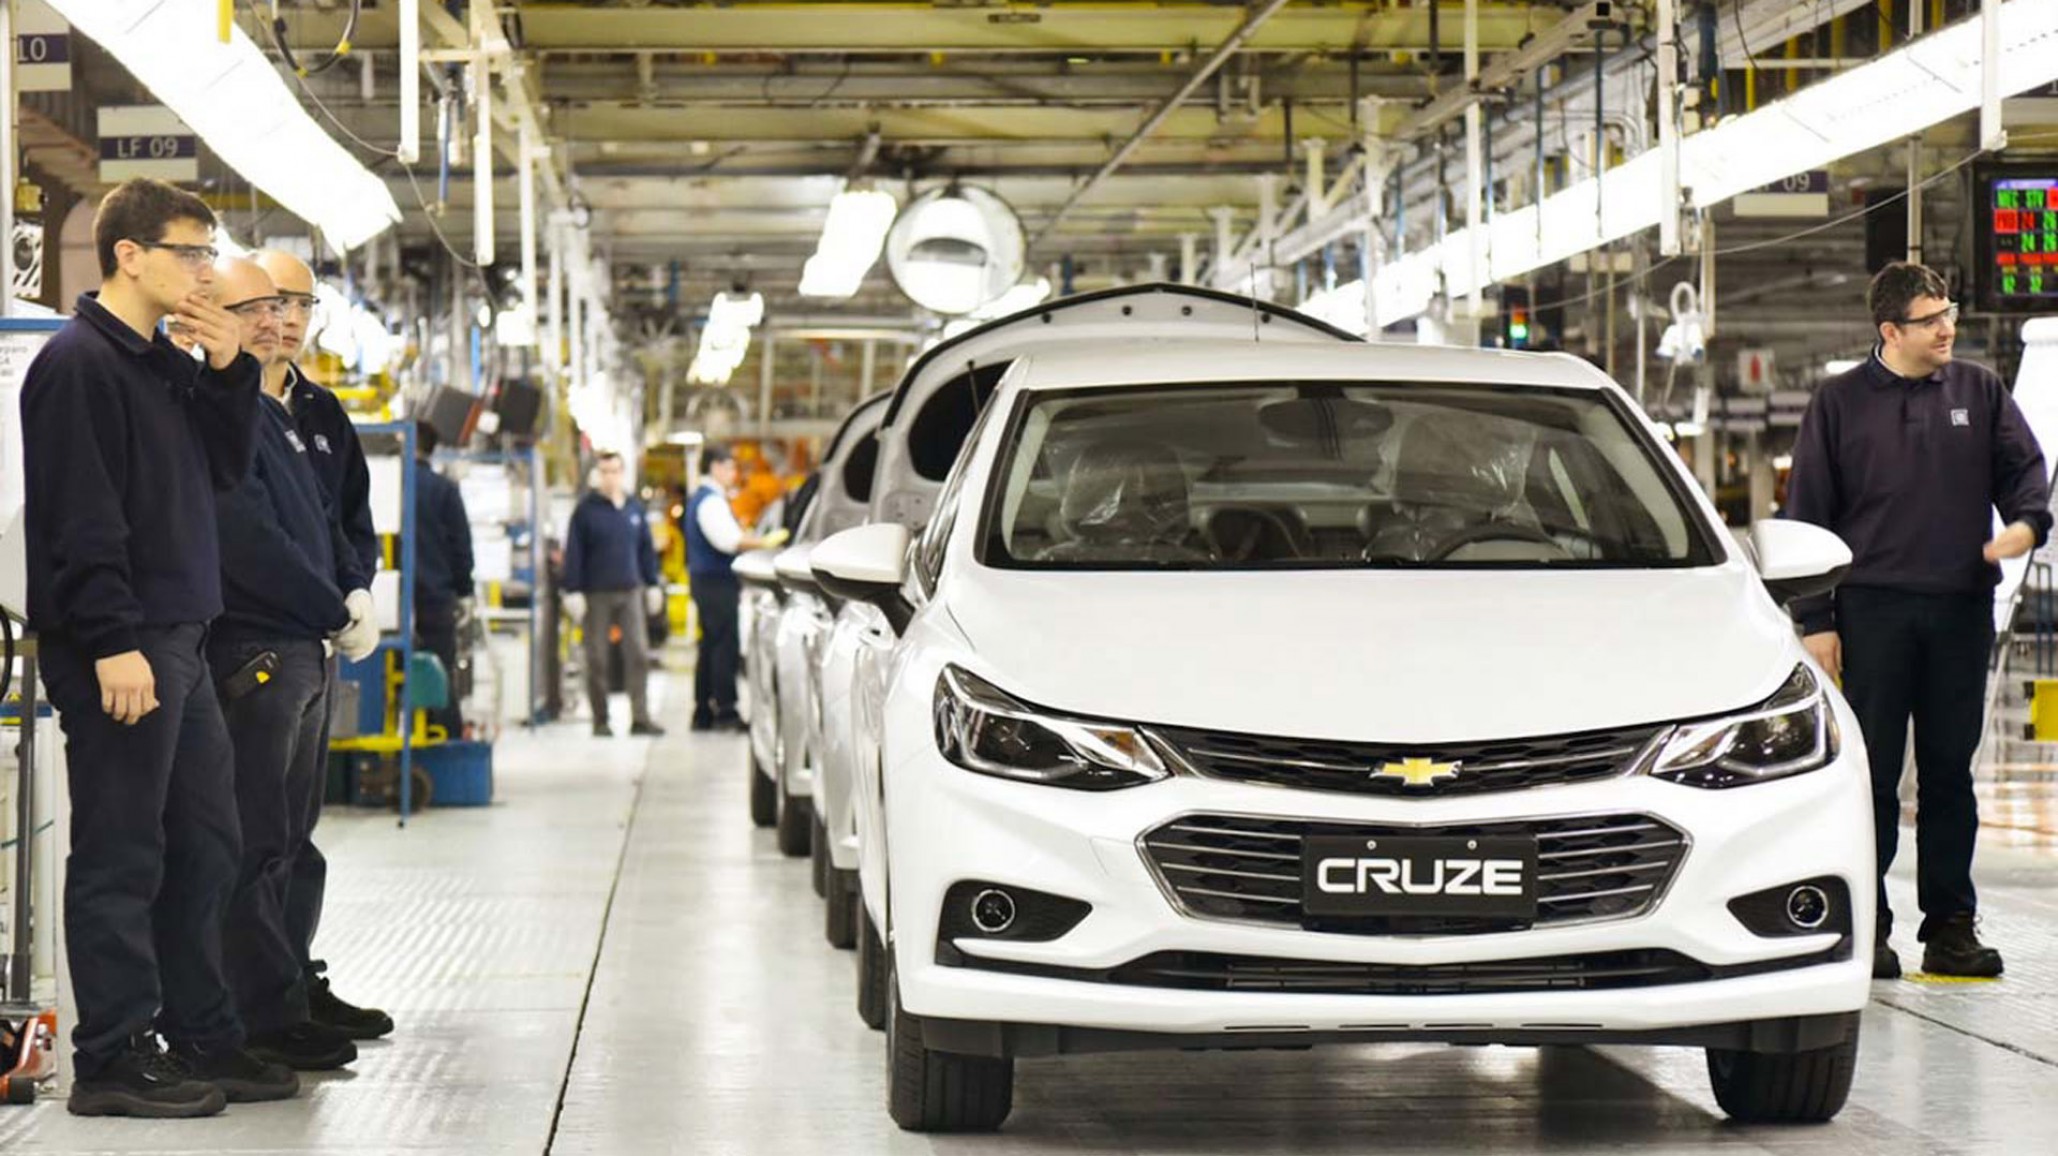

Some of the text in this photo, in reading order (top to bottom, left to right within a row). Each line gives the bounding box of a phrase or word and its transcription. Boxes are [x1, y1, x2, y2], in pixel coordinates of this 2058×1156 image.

[18, 37, 47, 61] 10
[117, 138, 178, 158] LF 09
[1317, 858, 1523, 895] CRUZE
